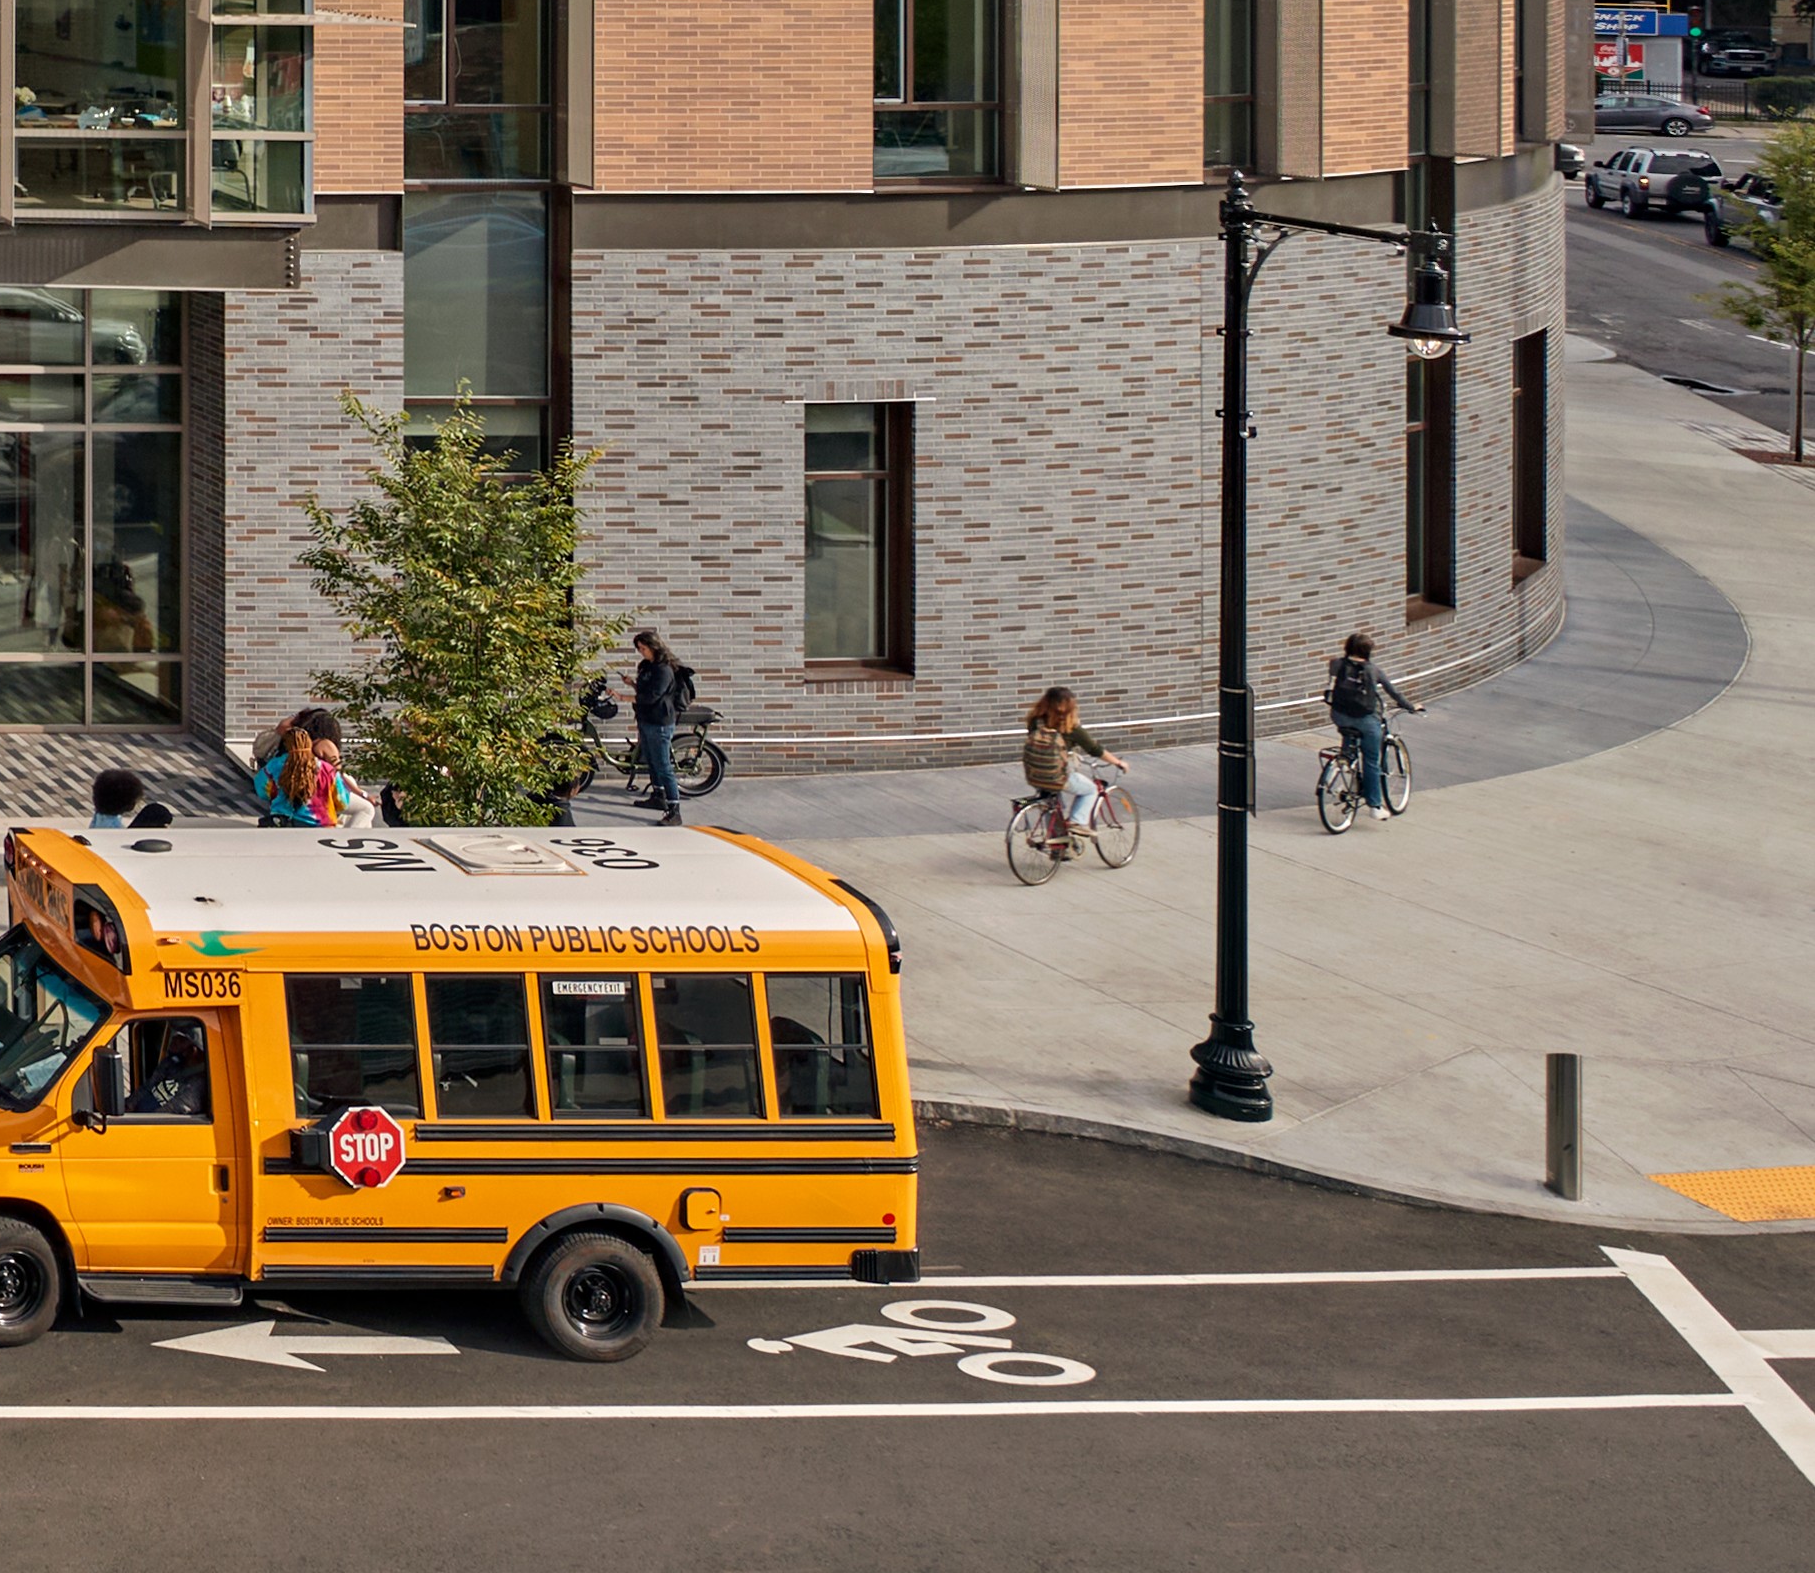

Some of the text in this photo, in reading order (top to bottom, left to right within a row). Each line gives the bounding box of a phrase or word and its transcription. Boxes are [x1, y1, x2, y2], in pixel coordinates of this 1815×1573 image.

[410, 924, 761, 954] BOSTON PUBLIC SCHOOLS
[164, 971, 241, 999] MS036
[557, 983, 621, 994] EMERGENCY EXIT
[340, 1132, 394, 1162] STOP
[267, 1216, 384, 1226] OWNER: BOSTON PUBLIC SCHOOLS
